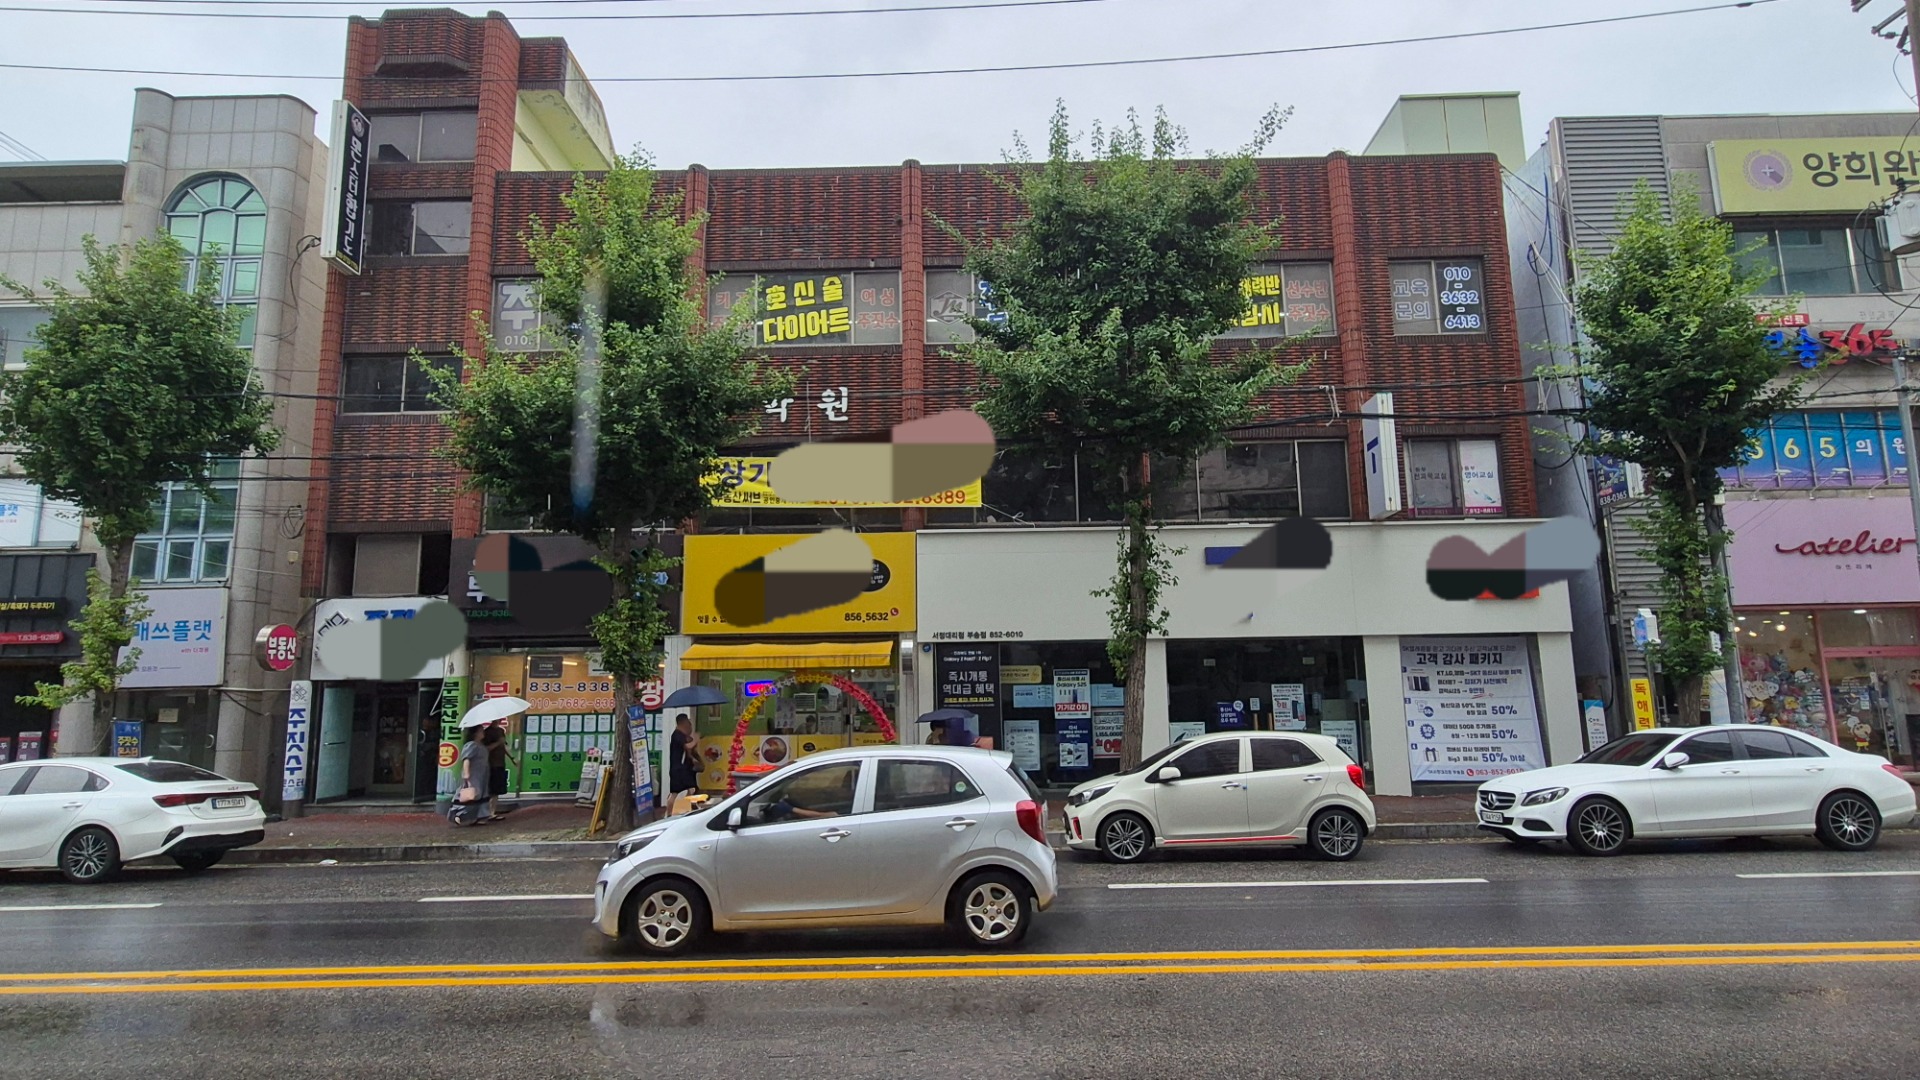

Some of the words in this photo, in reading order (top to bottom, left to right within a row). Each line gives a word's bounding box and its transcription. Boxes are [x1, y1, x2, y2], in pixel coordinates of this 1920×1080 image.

[343, 135, 362, 256] 몬스터합기도
[1444, 266, 1471, 280] 010
[766, 276, 843, 311] 호신술
[1286, 280, 1328, 299] 선수반
[1393, 279, 1429, 297] 교육
[860, 288, 895, 306] 여성
[1441, 290, 1479, 304] 3632
[1288, 303, 1331, 321] 주짓수
[1395, 301, 1431, 320] 문의
[762, 307, 850, 343] 다이어트
[857, 311, 900, 329] 주짓수
[1445, 314, 1480, 328] 6413
[1600, 490, 1627, 505] 838-0365
[1775, 530, 1916, 555] atelier
[466, 609, 513, 617] T.833-838
[844, 612, 889, 623] 856.5632
[268, 636, 297, 660] 부동산
[1416, 653, 1438, 665] 고객
[1442, 653, 1466, 665] 감사
[1469, 653, 1502, 665] 패키지
[948, 671, 988, 682] 즉시개통
[529, 682, 614, 692] 833-838
[943, 683, 972, 695] 역대급
[975, 683, 995, 694] 혜택
[529, 698, 616, 709] 010-7682-838
[1491, 705, 1517, 715] 50%
[1633, 682, 1651, 730] 독해력
[118, 736, 138, 746] 주짓수
[1491, 729, 1518, 739] 50%
[285, 708, 307, 775] 주짓수
[1481, 753, 1508, 763] 50%
